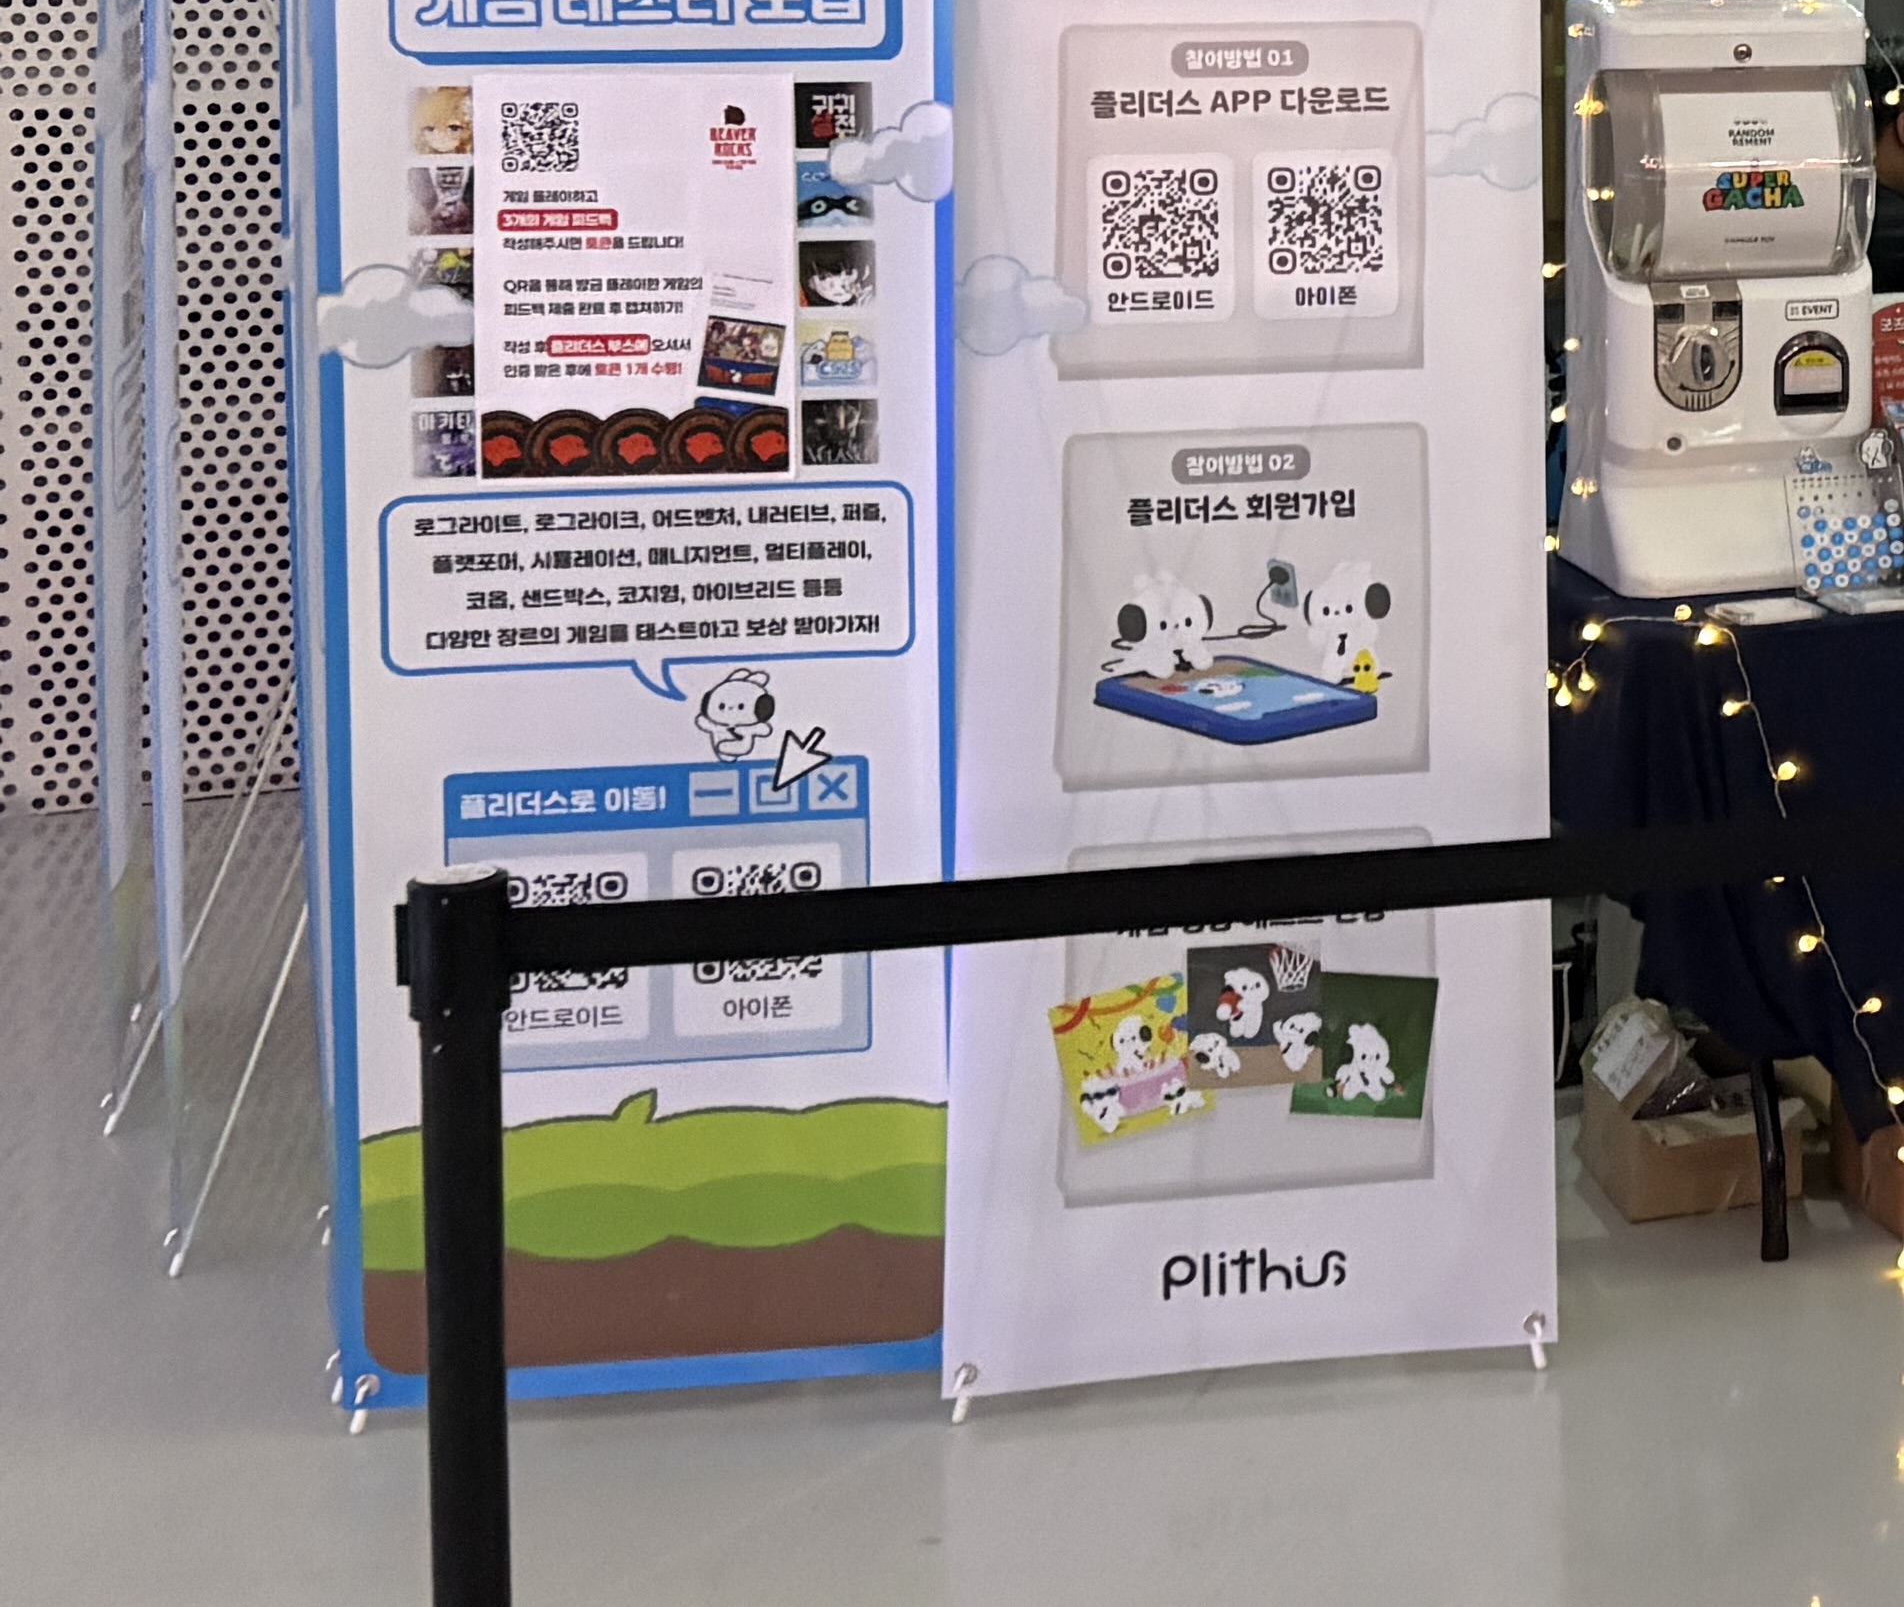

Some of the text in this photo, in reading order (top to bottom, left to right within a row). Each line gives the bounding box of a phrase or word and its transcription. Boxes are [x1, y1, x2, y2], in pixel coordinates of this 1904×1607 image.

[1185, 47, 1294, 69] 참여방법 01
[1091, 86, 1390, 118] 플리더스 APP 다운로드
[1716, 170, 1791, 191] SUPER
[1702, 185, 1804, 211] GACHA
[1107, 286, 1357, 313] 안드로이드 아이폰
[1802, 304, 1833, 315] EVENT
[1268, 453, 1296, 473] 02
[414, 514, 528, 537] 로그라이트,
[534, 510, 646, 533] 로그라이크,
[652, 507, 742, 528] 어드벤처,
[748, 503, 836, 525] 내러티브,
[1127, 490, 1356, 527] 플리더스 회원가입
[433, 541, 872, 574] 플랫포머, 시뮬레이션, 매니지먼트, 멀티플레이,
[466, 590, 514, 611] 코옵,
[521, 586, 611, 608] 샌드박스,
[692, 579, 797, 602] 하이브리드
[426, 614, 880, 651] 다양한 장르의 게임을 테스트하고 보상 받아가자!
[460, 786, 667, 819] 플리더스로 이동!
[504, 996, 794, 1032] 안드로이드 아이폰
